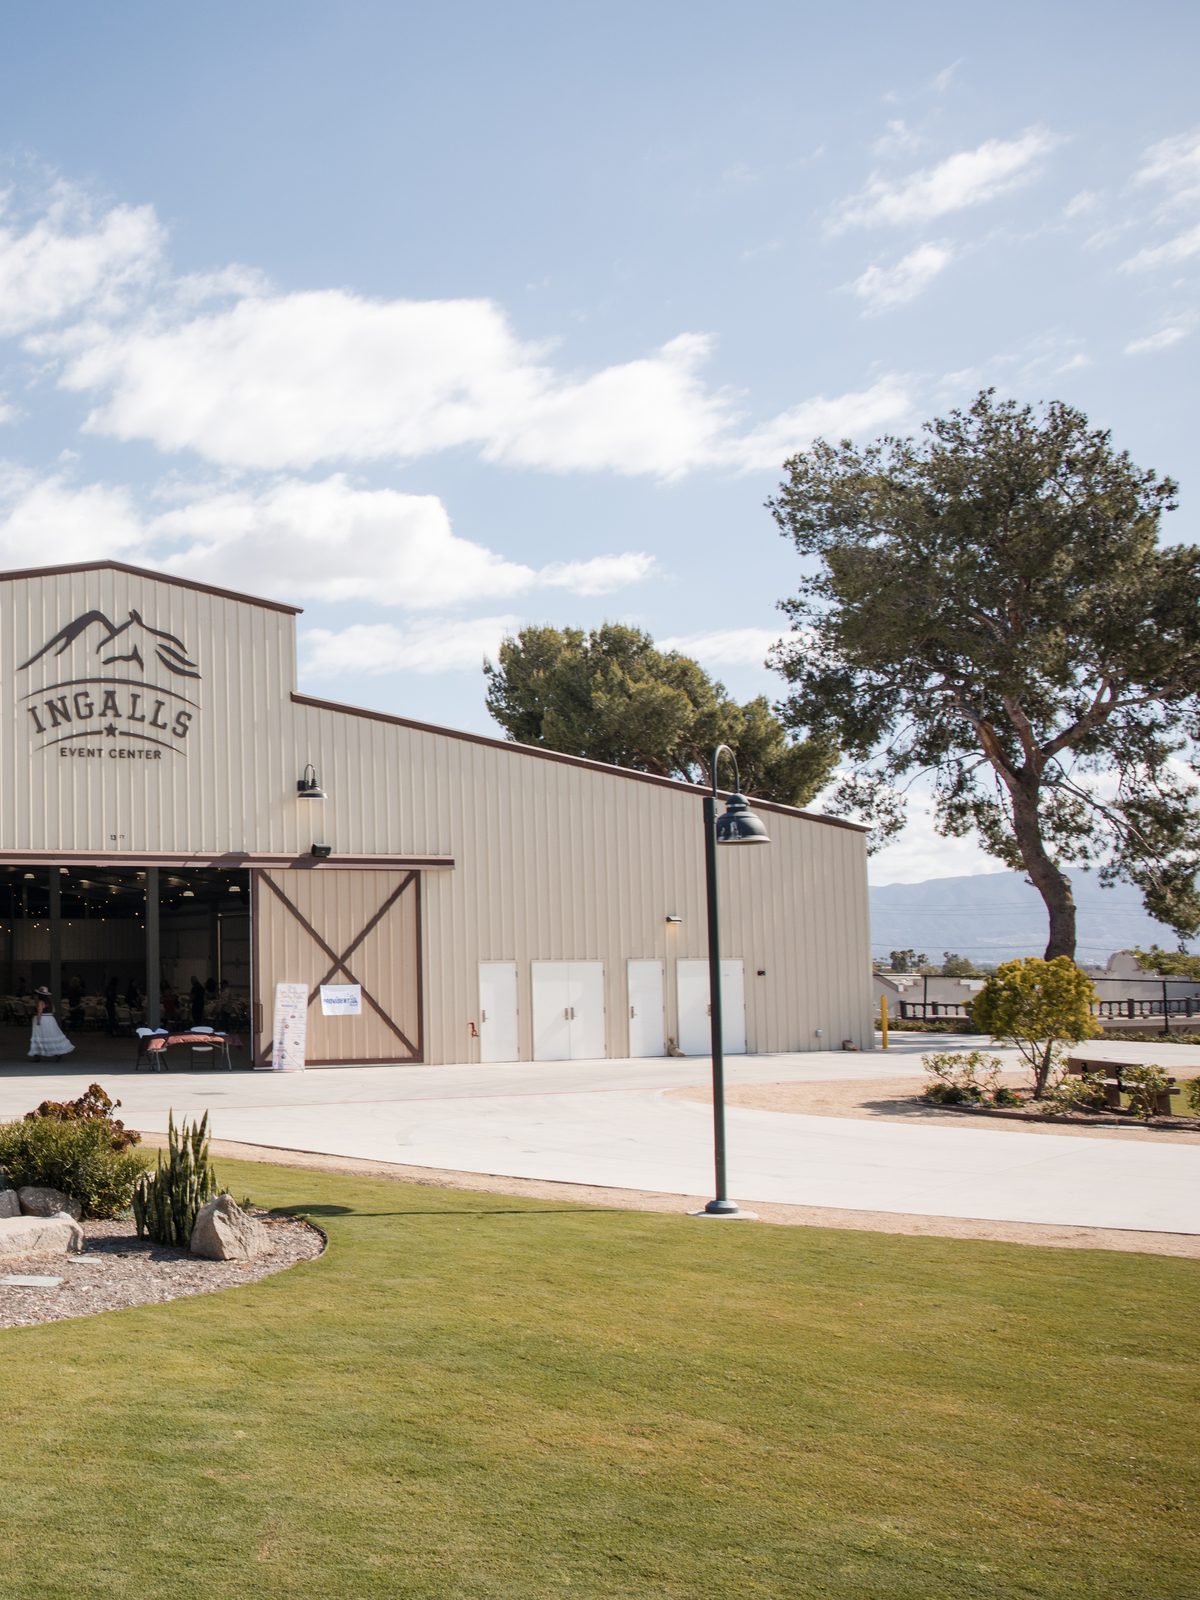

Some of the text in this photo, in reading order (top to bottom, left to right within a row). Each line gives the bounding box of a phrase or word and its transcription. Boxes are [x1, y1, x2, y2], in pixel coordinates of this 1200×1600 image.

[27, 690, 193, 739] INGALLS
[60, 747, 162, 760] EVENT CENTER
